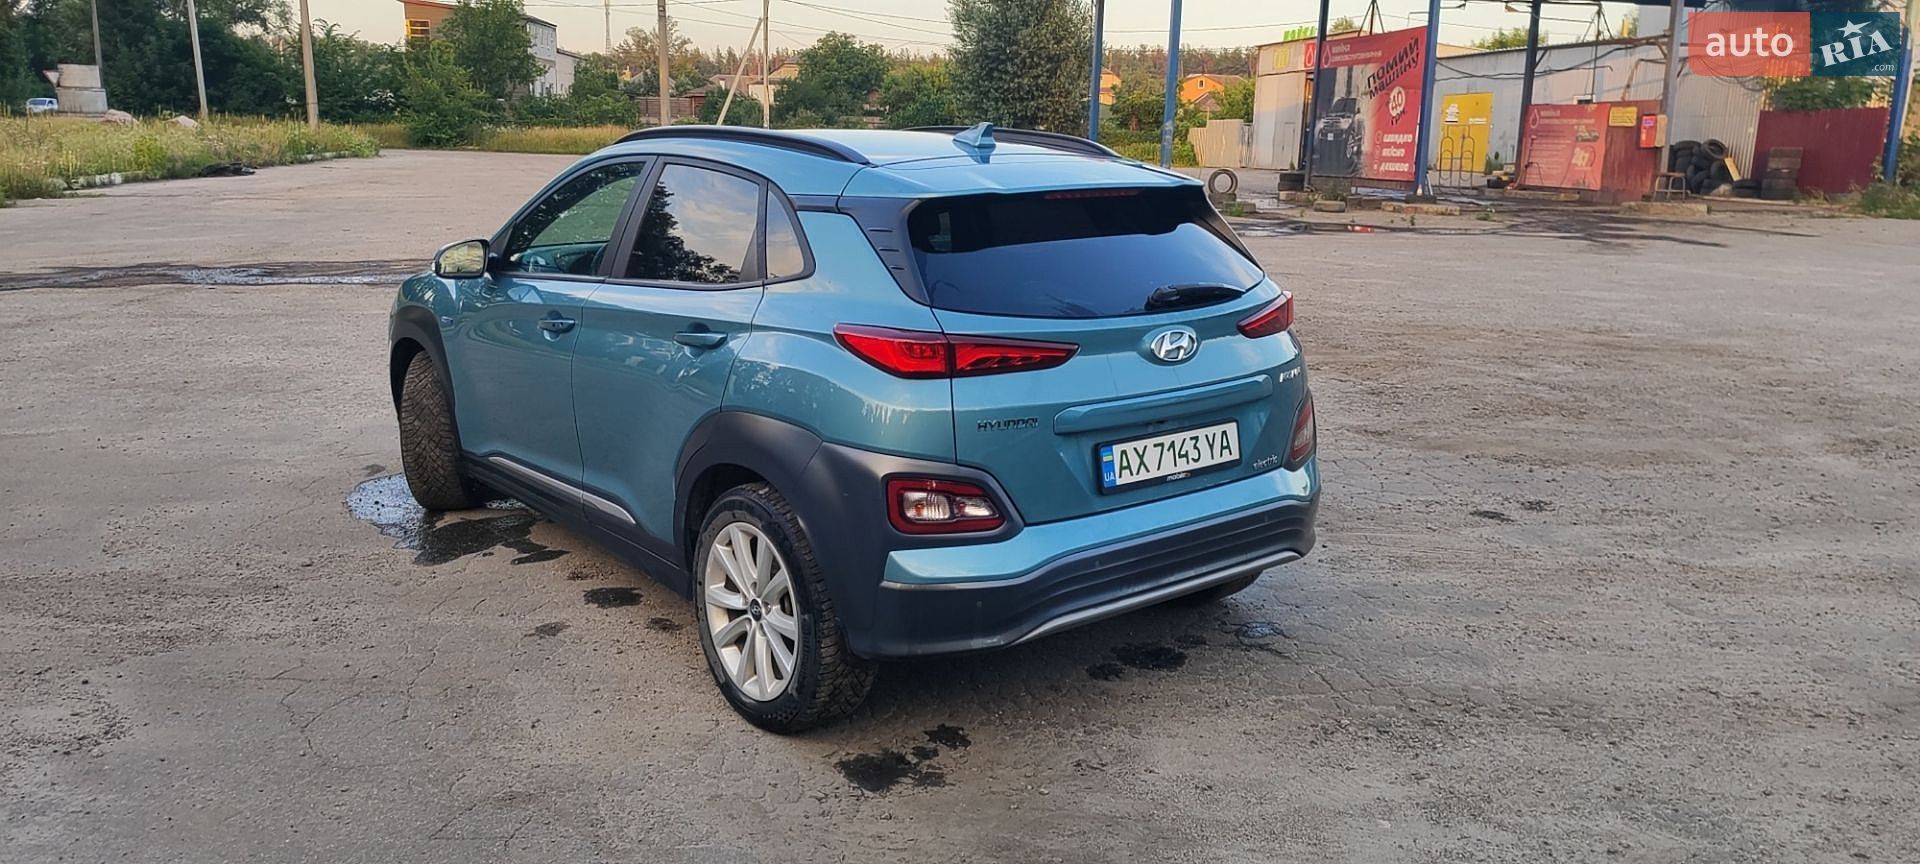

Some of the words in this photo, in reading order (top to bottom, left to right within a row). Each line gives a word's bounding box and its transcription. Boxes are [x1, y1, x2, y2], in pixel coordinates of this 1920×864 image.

[1367, 36, 1419, 88] ПОМИЙ
[976, 417, 1039, 431] HYUNDAI
[1118, 445, 1150, 479] AX
[1153, 435, 1202, 472] 7143
[1205, 429, 1233, 461] YA
[1104, 472, 1115, 482] UA
